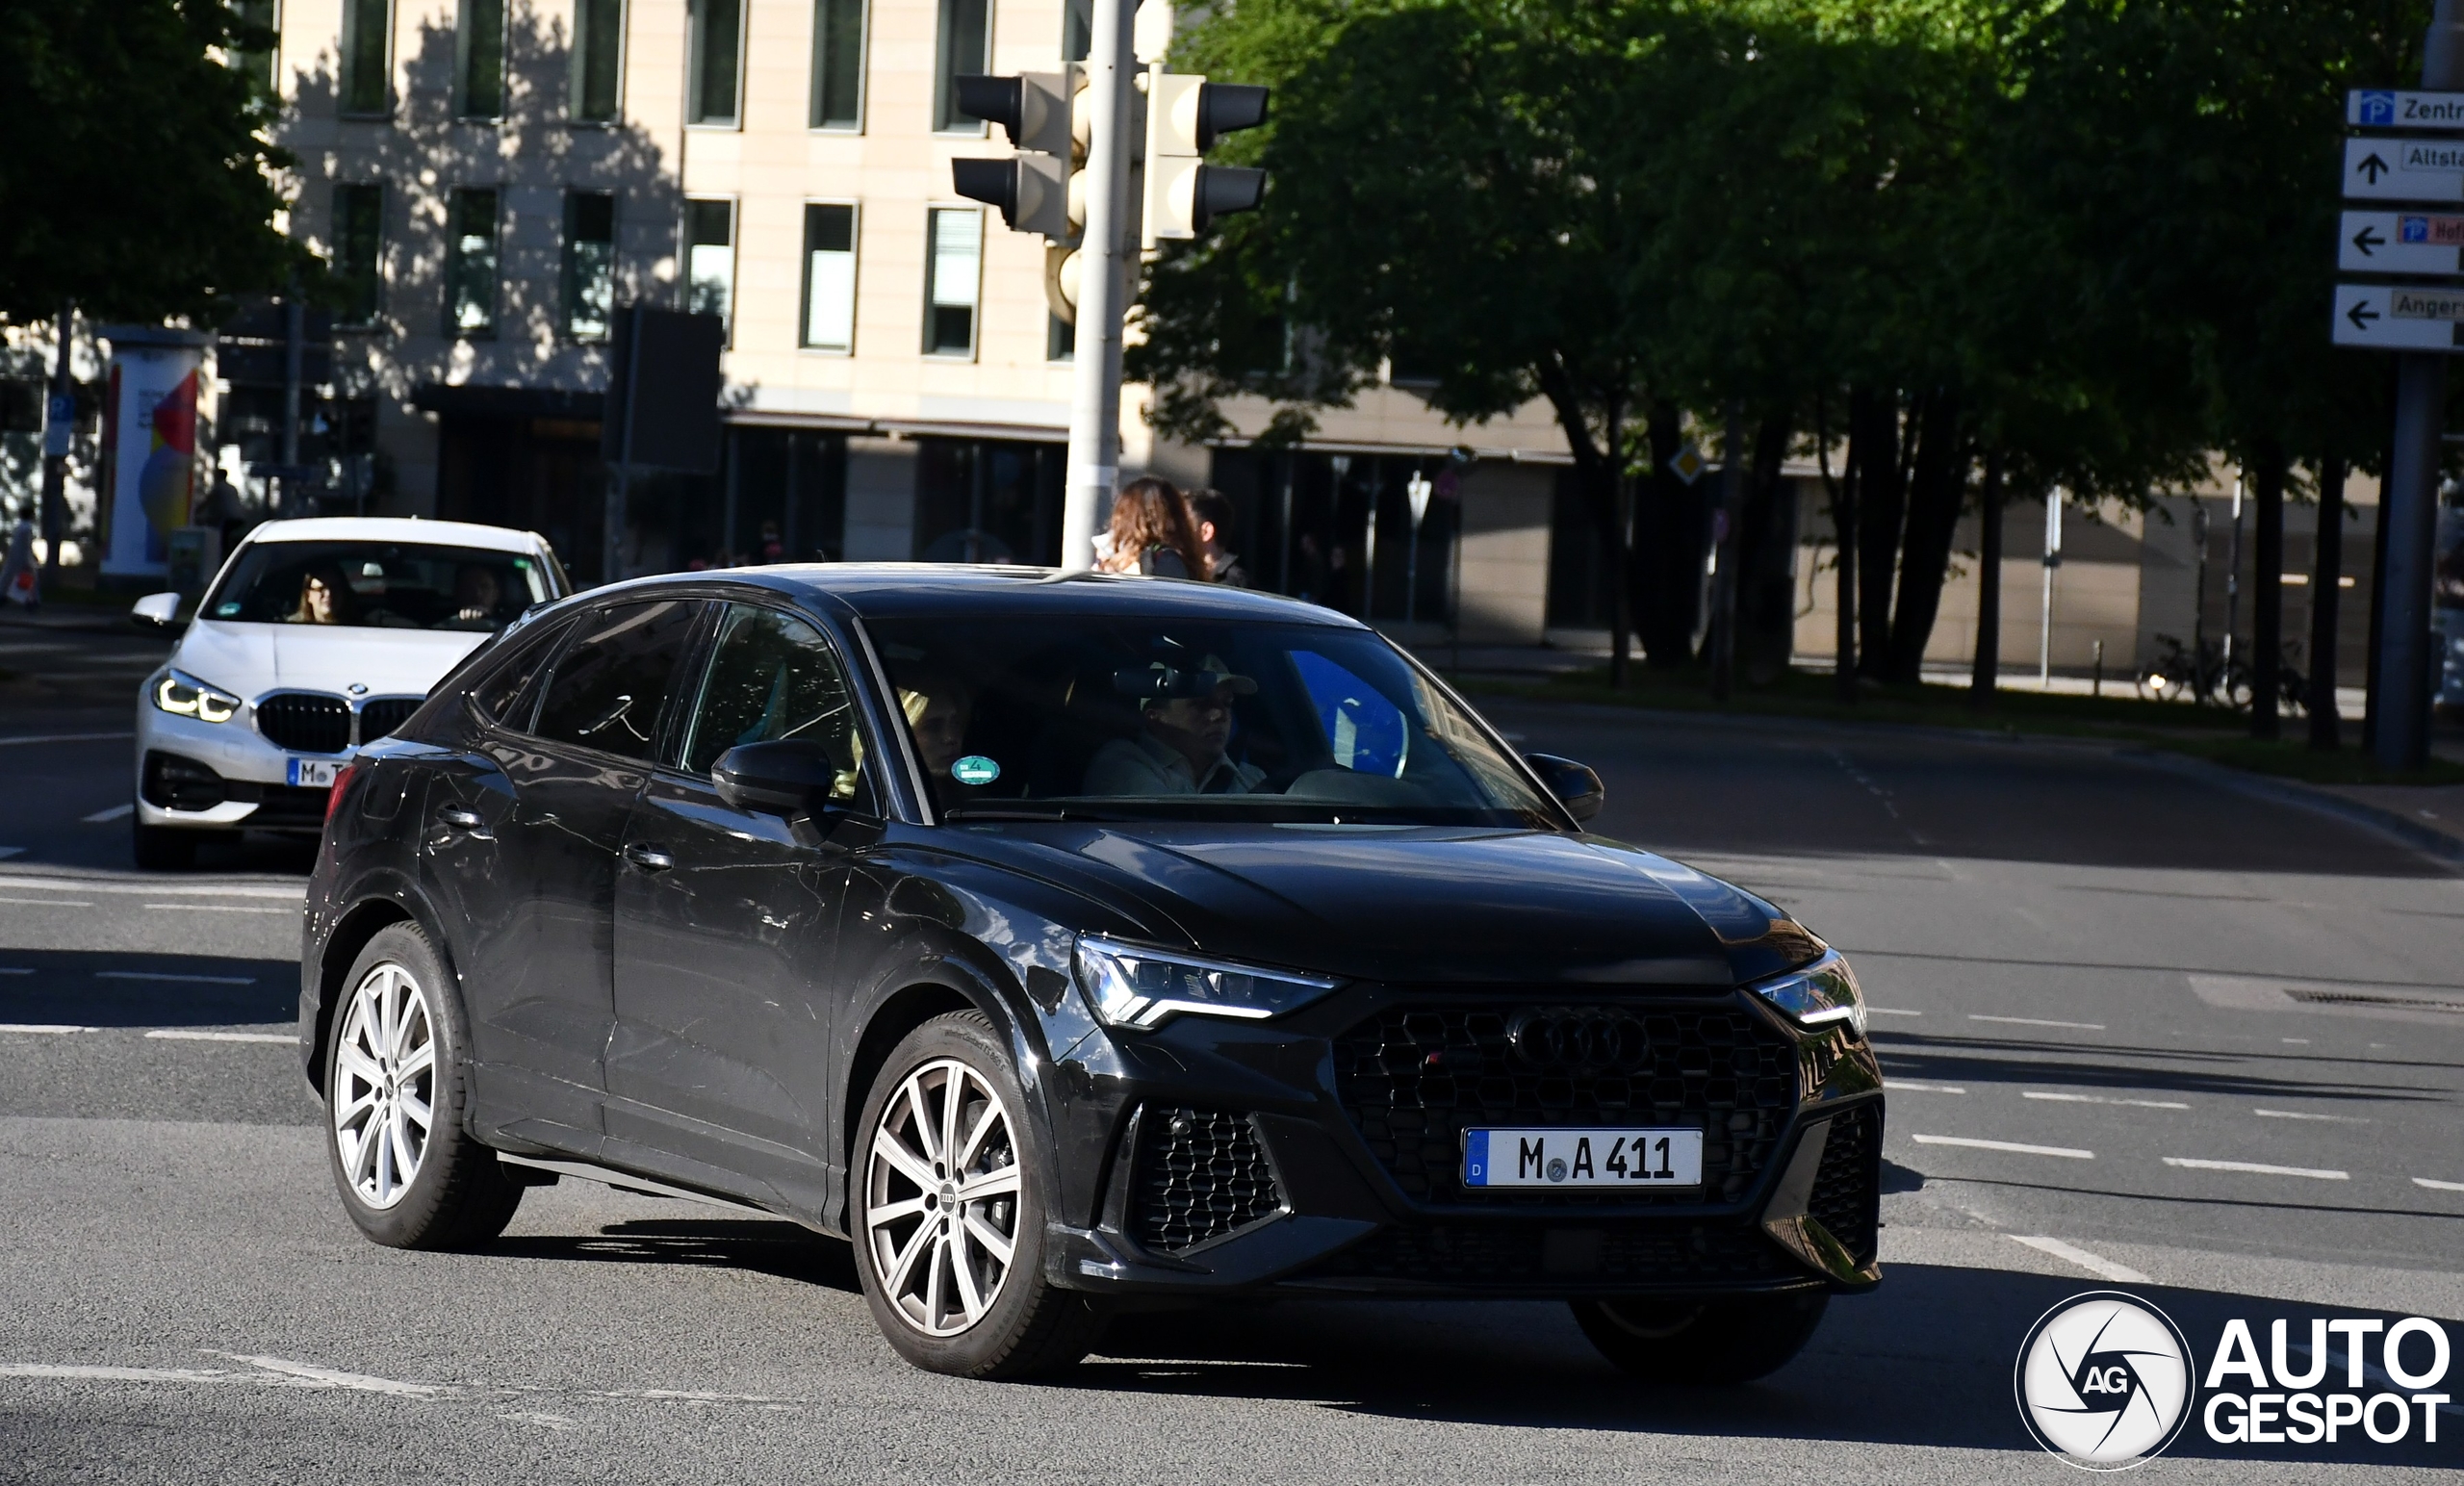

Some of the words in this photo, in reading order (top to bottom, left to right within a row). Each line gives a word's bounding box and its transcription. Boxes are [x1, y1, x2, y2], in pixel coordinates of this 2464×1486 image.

[2404, 97, 2464, 119] Zentr
[2435, 220, 2464, 239] Hof
[2398, 294, 2464, 320] Anger
[301, 762, 315, 782] M
[970, 760, 981, 771] 4
[1519, 1137, 1544, 1179] M
[1572, 1137, 1595, 1179] A
[1605, 1137, 1675, 1179] 411
[1472, 1164, 1481, 1176] D
